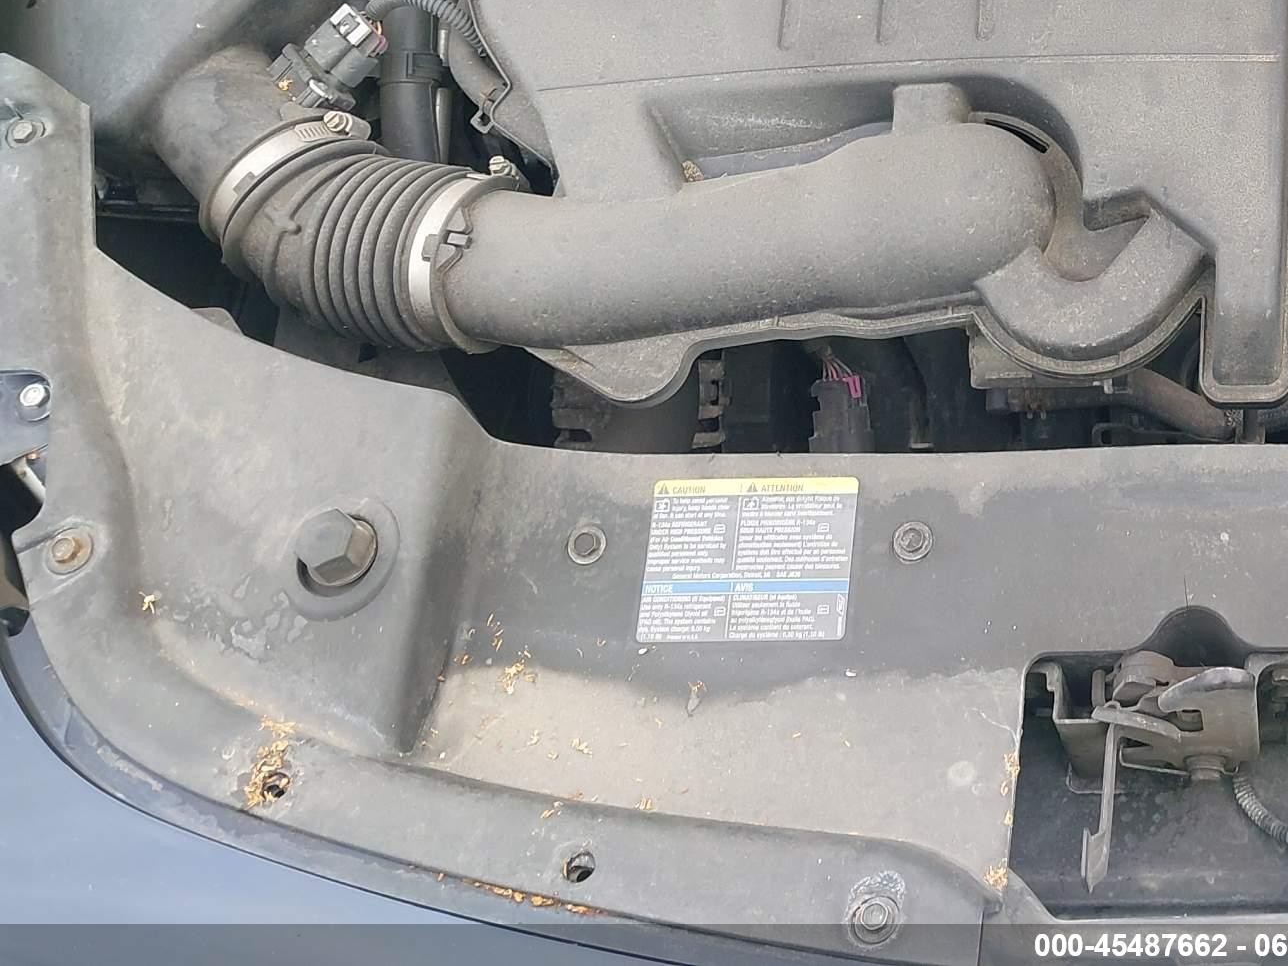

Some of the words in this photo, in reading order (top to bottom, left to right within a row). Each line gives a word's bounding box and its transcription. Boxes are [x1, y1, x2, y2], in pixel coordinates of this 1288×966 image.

[672, 485, 706, 495] CAUTION
[761, 484, 804, 493] ATTENTION
[645, 584, 673, 594] NOTICE
[734, 582, 754, 593] AVIS
